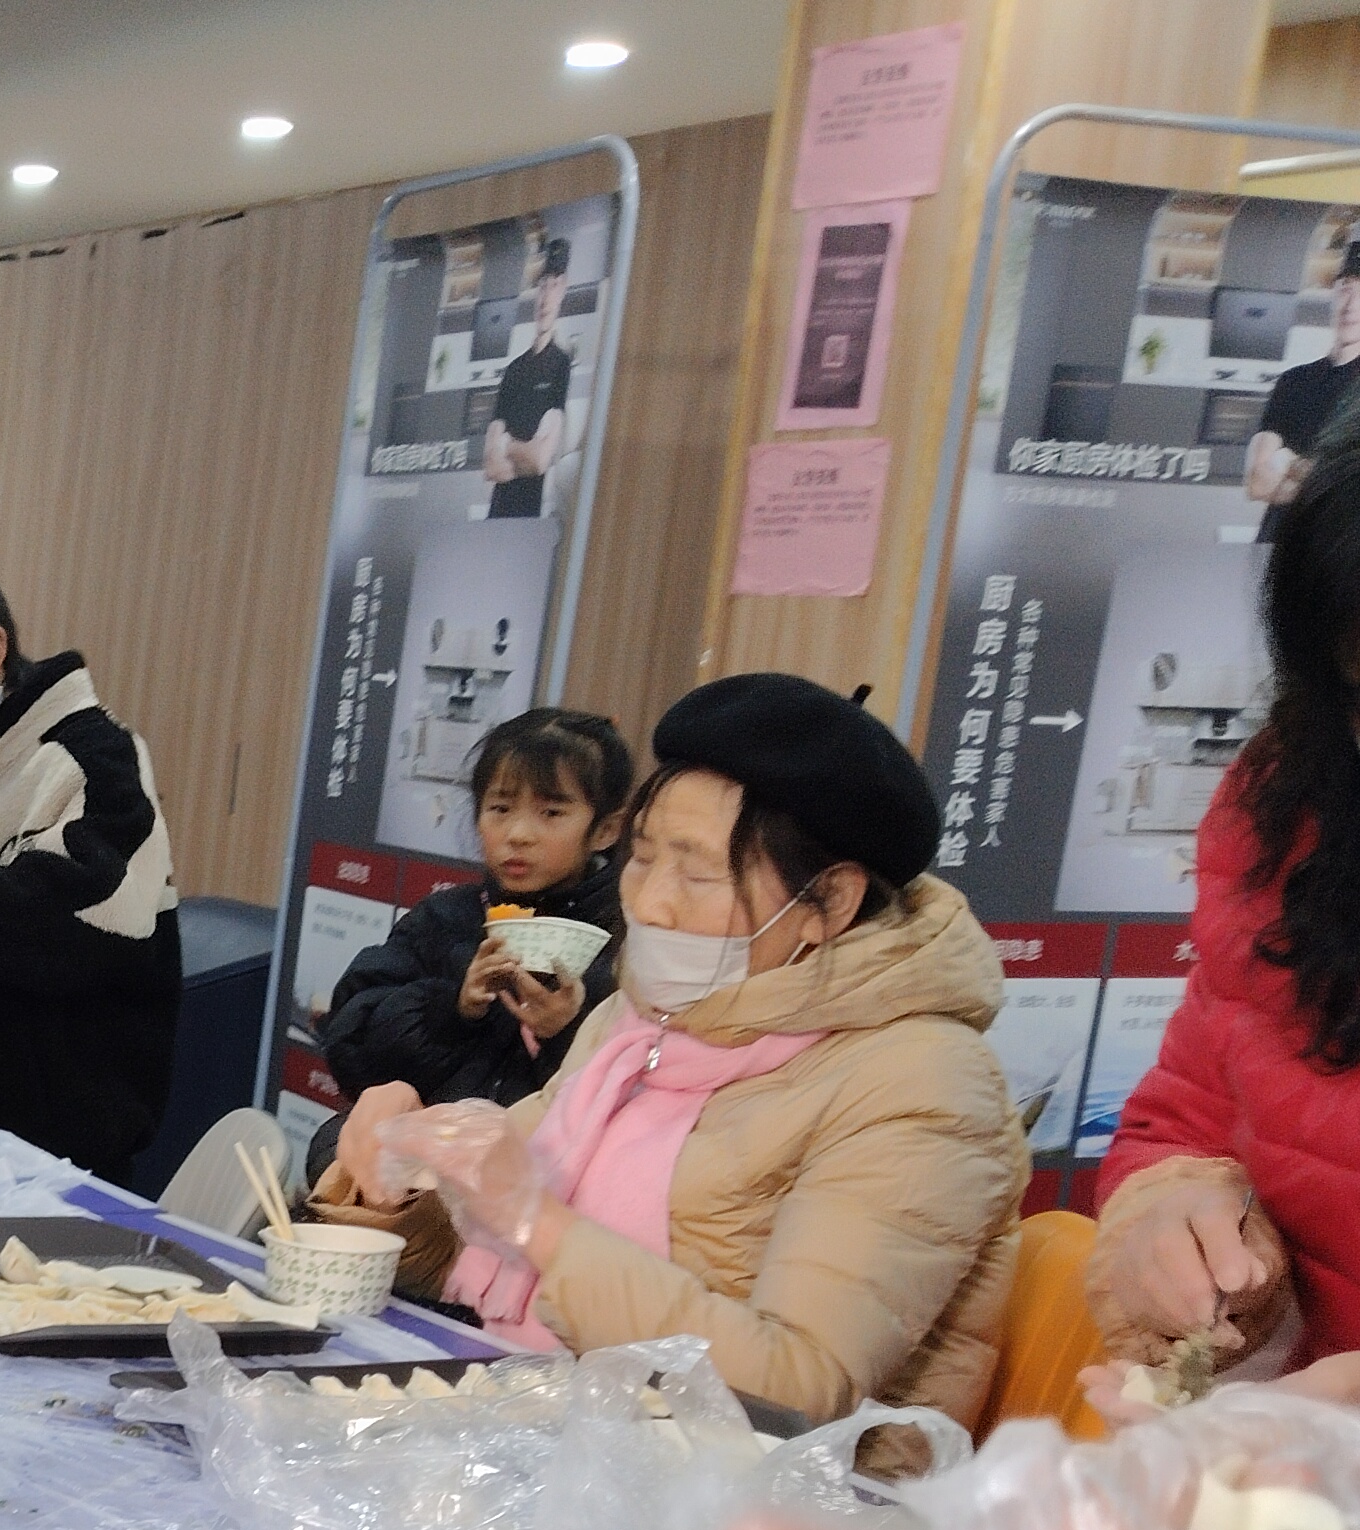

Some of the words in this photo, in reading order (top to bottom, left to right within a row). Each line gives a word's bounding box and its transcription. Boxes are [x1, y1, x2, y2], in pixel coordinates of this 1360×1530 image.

[1009, 437, 1211, 482] 你家厨房体检了吗
[936, 575, 1017, 868] 厨房为何要体检
